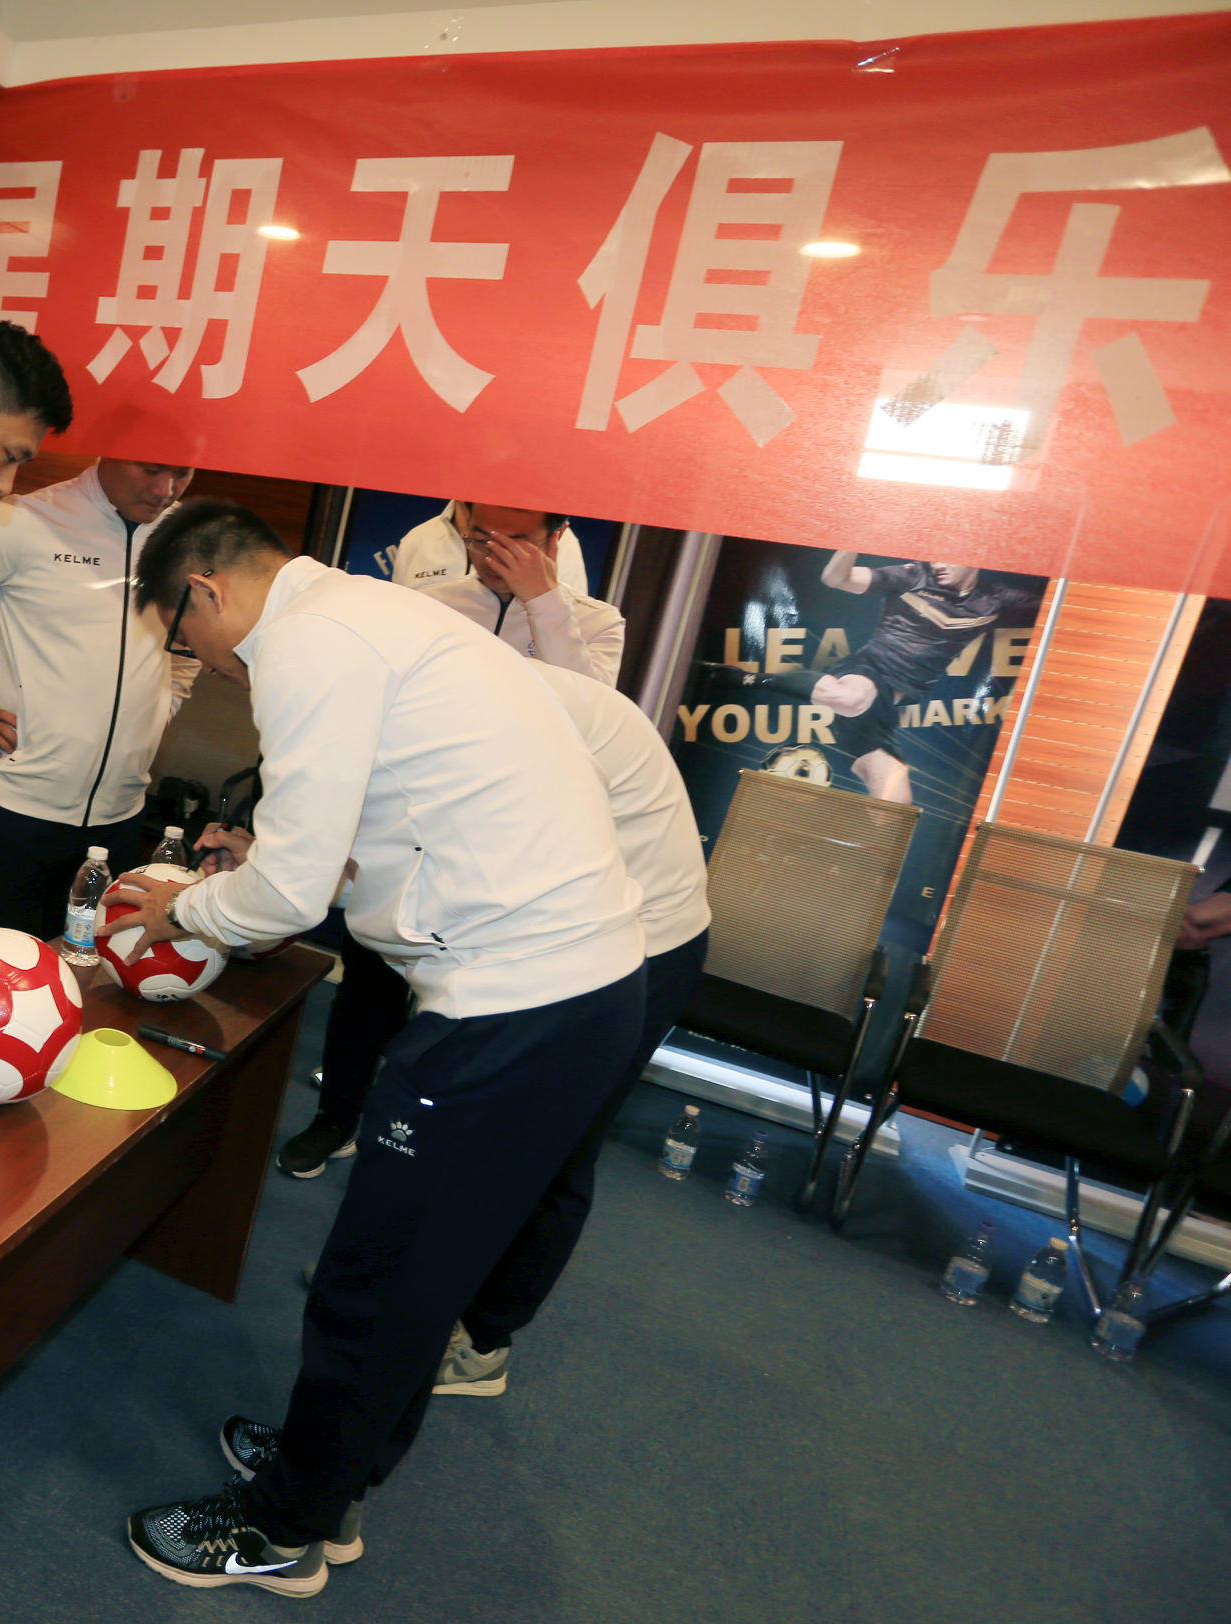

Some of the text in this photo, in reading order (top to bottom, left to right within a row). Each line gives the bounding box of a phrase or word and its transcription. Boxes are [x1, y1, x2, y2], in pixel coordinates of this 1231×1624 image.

[53, 553, 102, 567] KELME
[415, 568, 447, 579] KELME
[677, 704, 836, 744] YOUR
[377, 1136, 416, 1157] KELME
